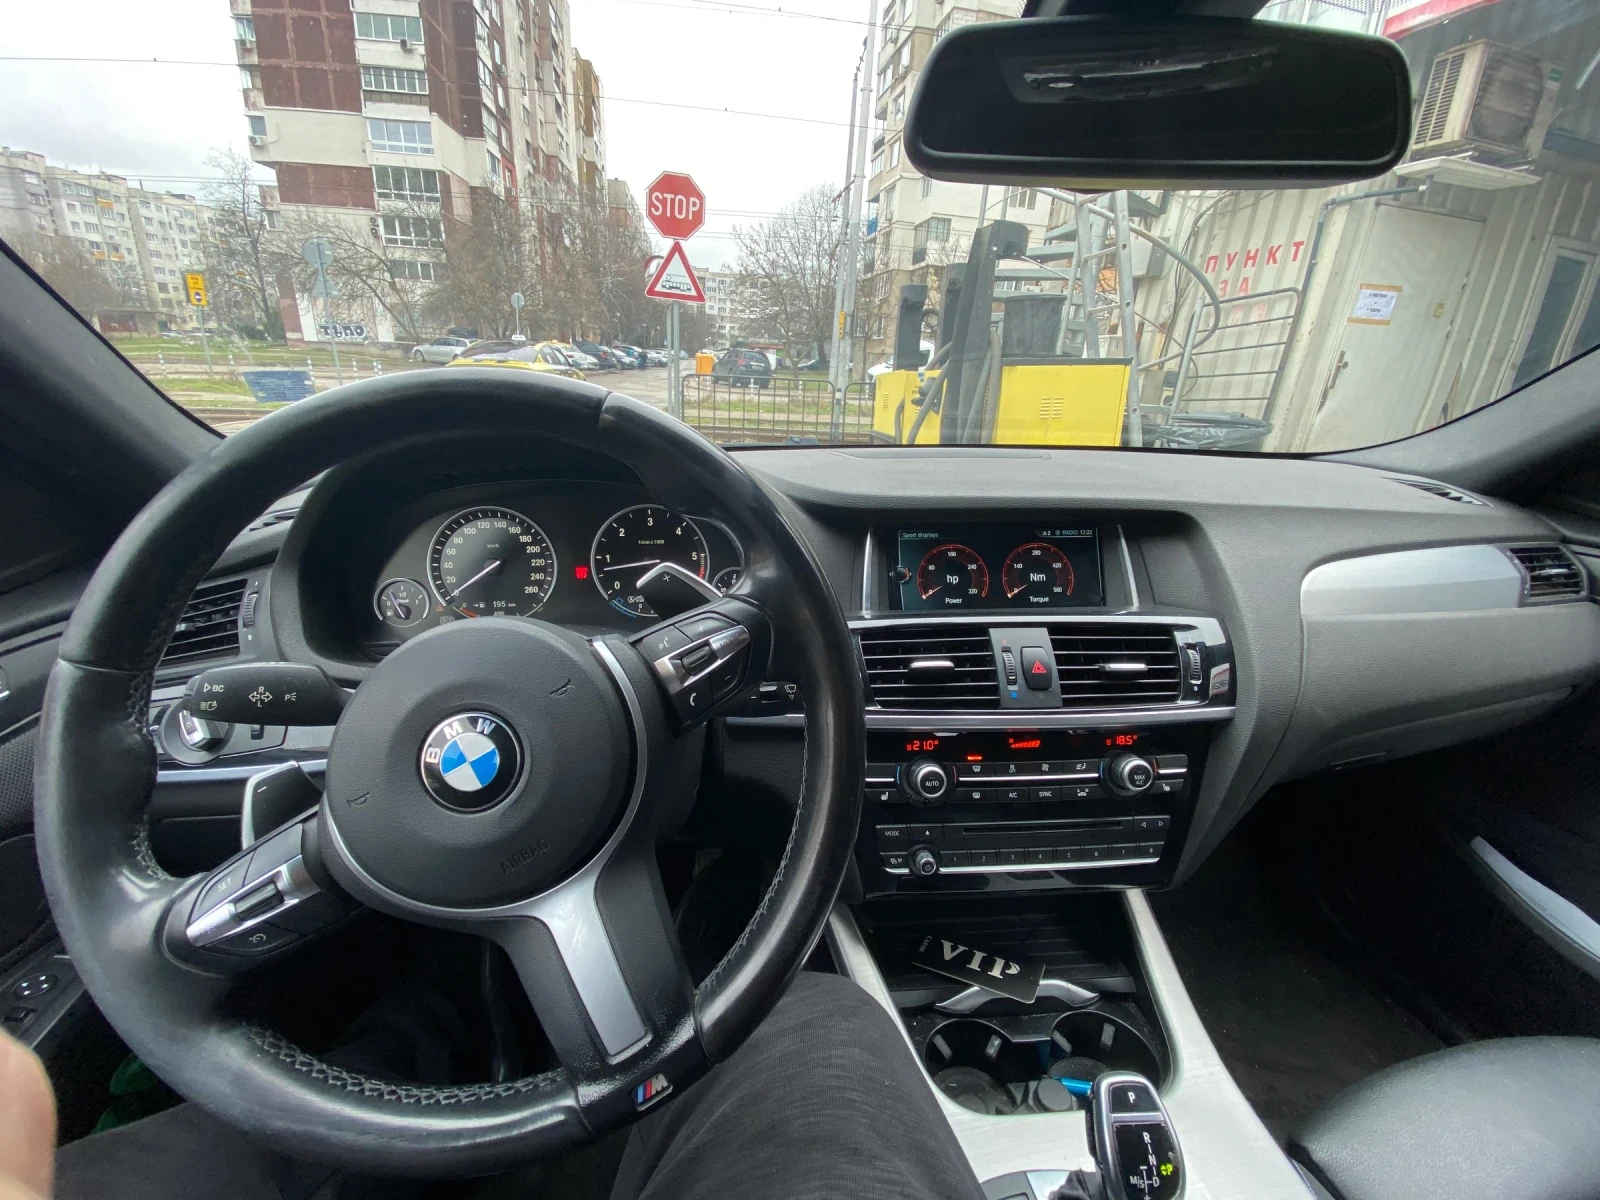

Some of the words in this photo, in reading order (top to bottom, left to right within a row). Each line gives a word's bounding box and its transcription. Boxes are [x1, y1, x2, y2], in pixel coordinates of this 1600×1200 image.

[651, 191, 700, 220] STOP
[1205, 241, 1305, 274] ПУНКТ
[1219, 277, 1249, 298] ЗА
[494, 521, 507, 529] 140
[647, 517, 653, 526] 3
[619, 528, 625, 537] 2
[675, 527, 682, 536] 4
[453, 536, 463, 544] 80
[519, 535, 532, 543] 180
[605, 554, 610, 563] 1
[691, 552, 698, 561] 5
[946, 574, 959, 585] hp
[1030, 573, 1046, 582] Nm
[524, 586, 539, 594] 260
[613, 581, 620, 590] 0
[212, 684, 225, 693] BC
[259, 686, 265, 694] R
[425, 718, 497, 764] BMW
[500, 839, 549, 874] AIRBAG
[217, 878, 232, 893] SET
[941, 939, 1021, 979] VIP
[1128, 1091, 1136, 1104] P
[1143, 1131, 1151, 1144] R
[1149, 1154, 1157, 1166] N
[1166, 1163, 1173, 1176] P
[1153, 1176, 1160, 1187] D
